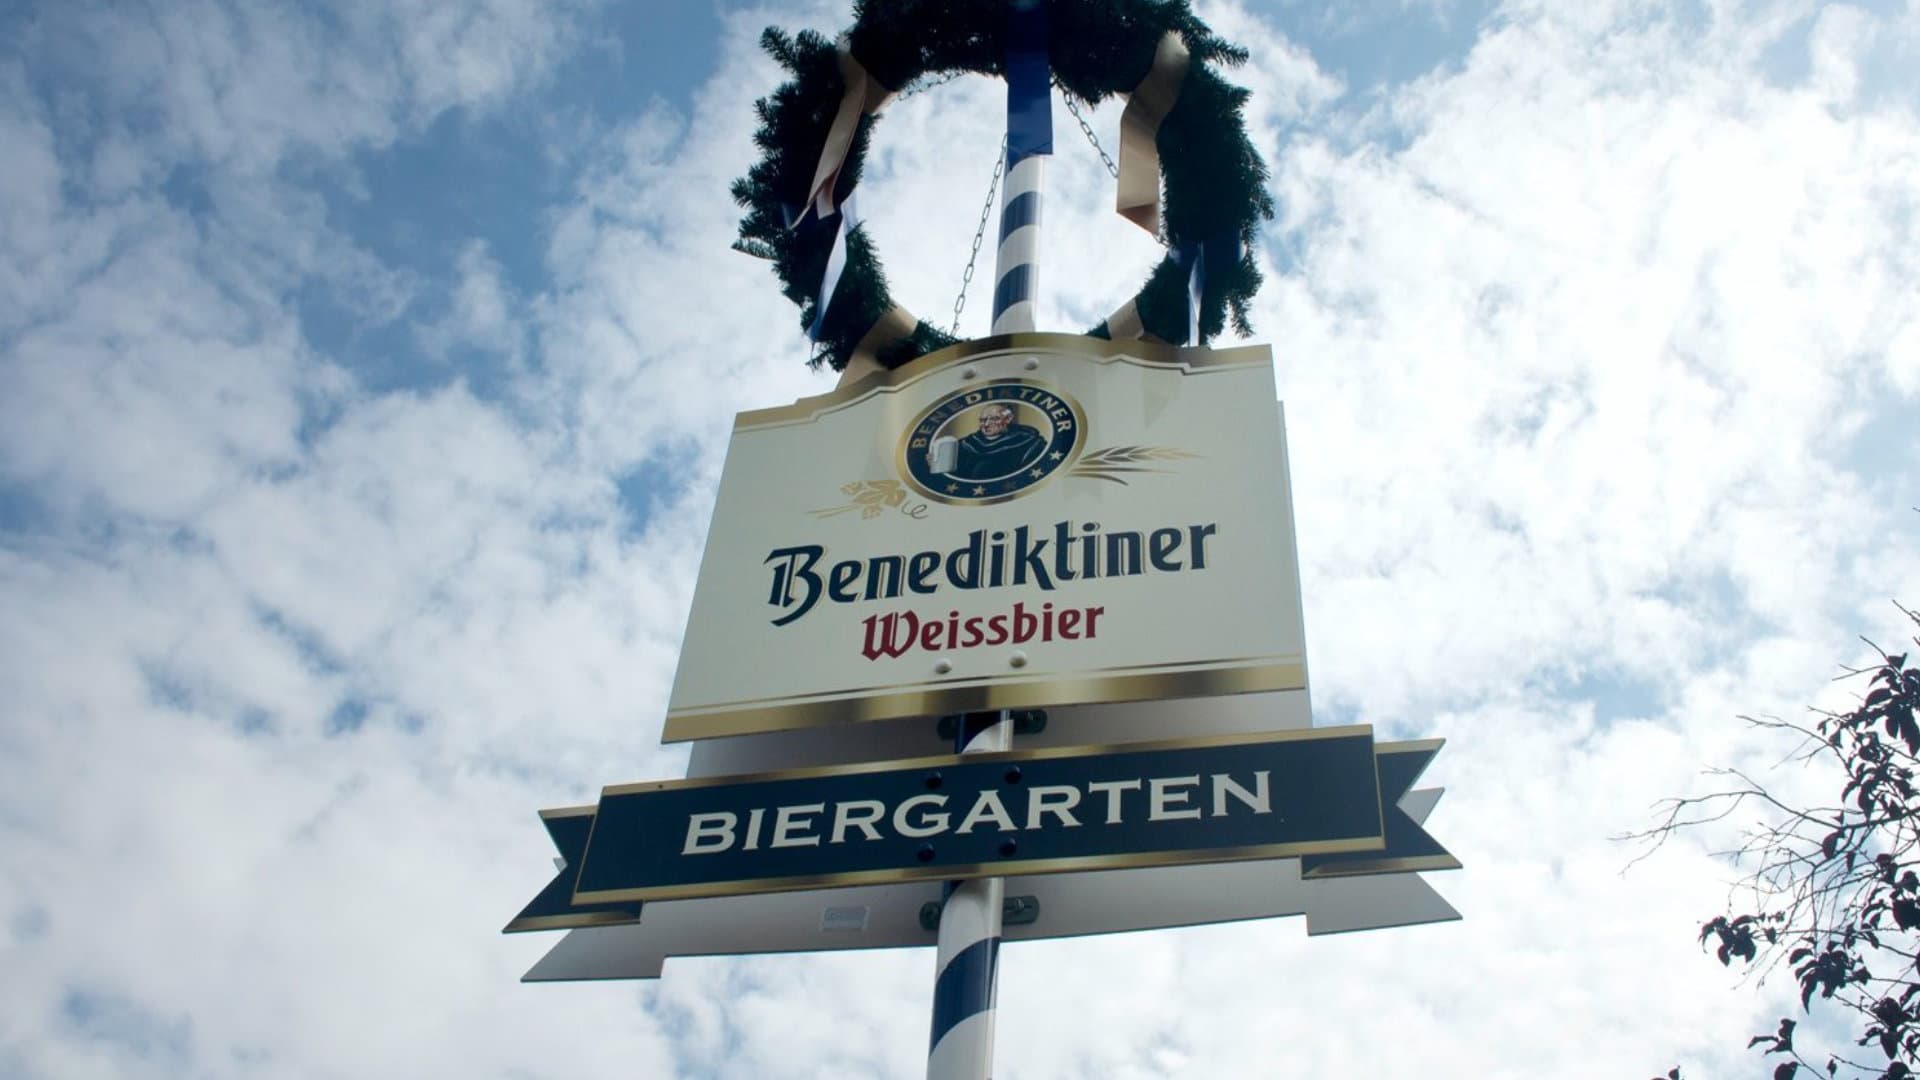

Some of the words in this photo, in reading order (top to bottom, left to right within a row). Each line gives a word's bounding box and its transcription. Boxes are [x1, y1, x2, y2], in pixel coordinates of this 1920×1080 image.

[912, 387, 1072, 449] BENEDITINER
[764, 520, 1217, 627] Benediktiner
[861, 602, 1105, 661] Weissbier
[681, 770, 1272, 855] BIERGARTEN
